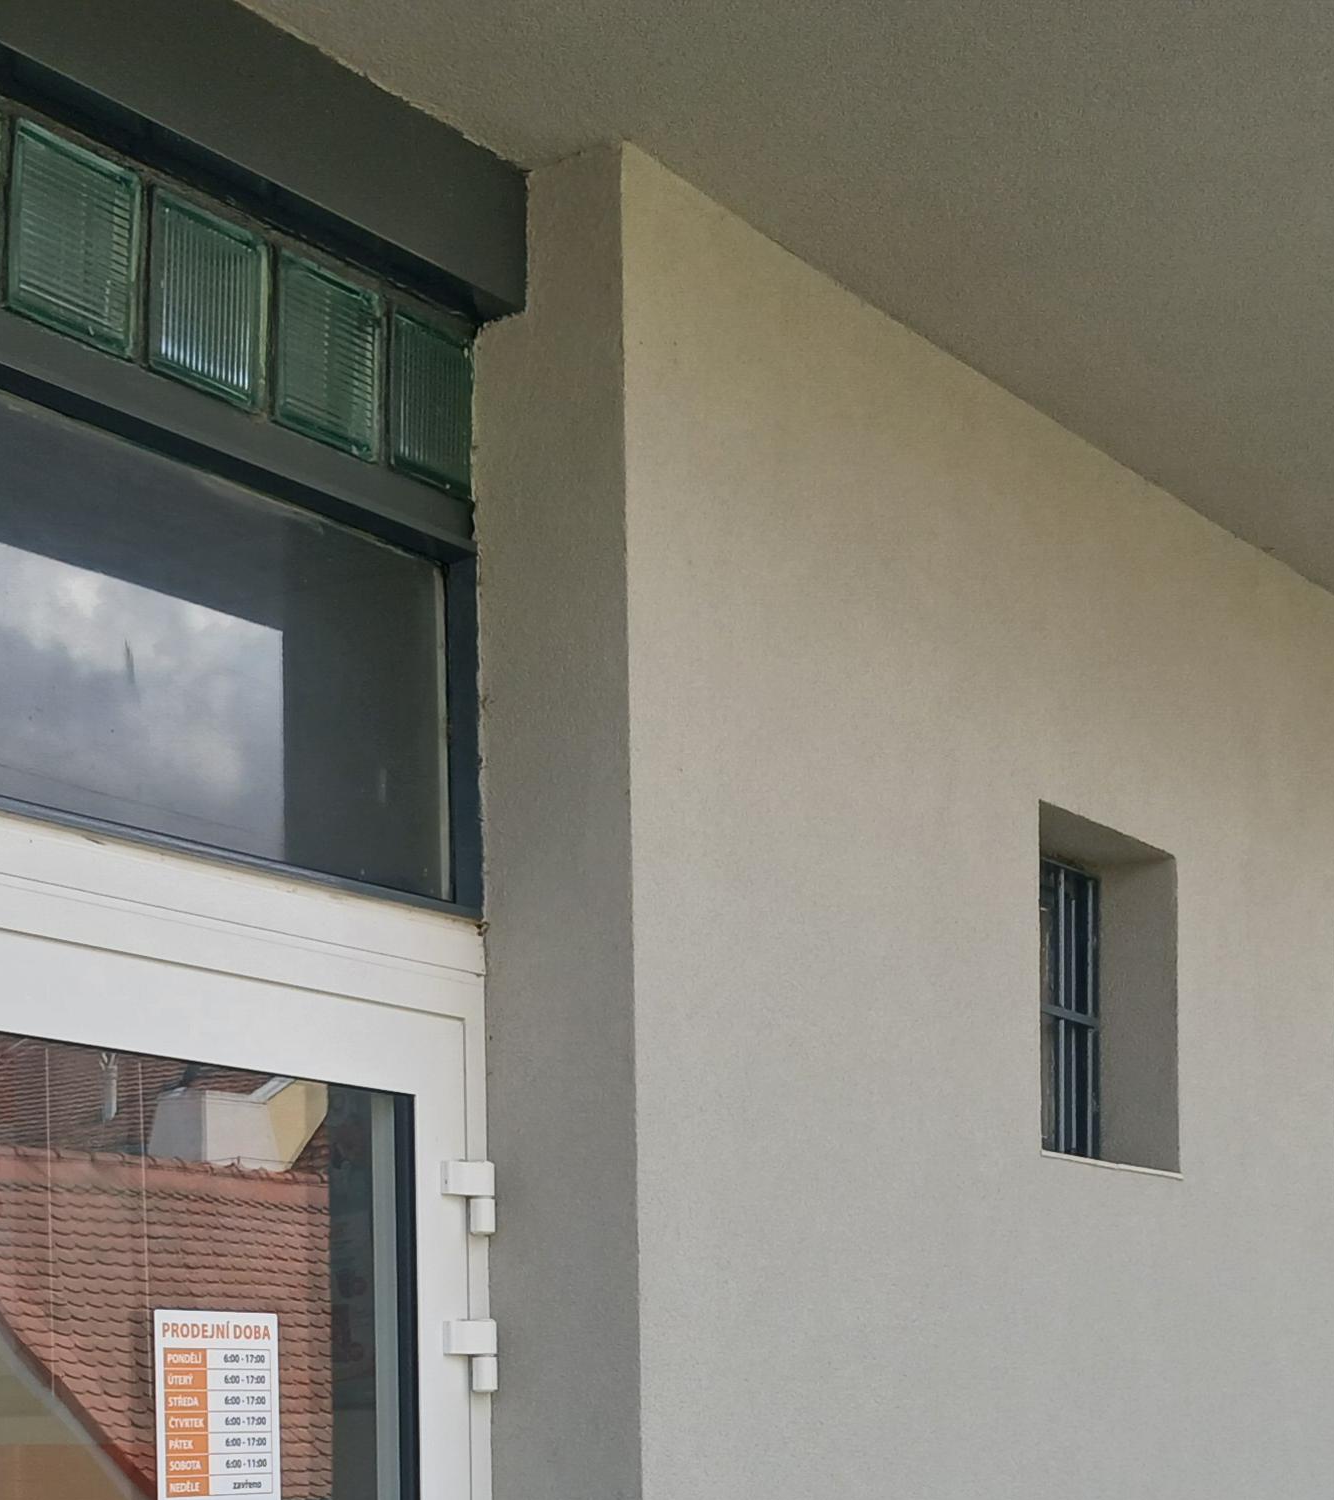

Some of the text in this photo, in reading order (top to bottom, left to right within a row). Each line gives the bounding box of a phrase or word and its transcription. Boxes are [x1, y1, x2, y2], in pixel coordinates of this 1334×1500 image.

[162, 1321, 271, 1340] PRODEJNÍ DOBA
[167, 1352, 202, 1365] PONDĚLÍ
[223, 1354, 240, 1364] 6:00
[246, 1354, 265, 1364] 17:00
[167, 1373, 193, 1385] ÚTERÝ
[224, 1375, 240, 1384] 6:00
[246, 1375, 266, 1384] 17:00
[168, 1395, 199, 1407] STŘEDA
[224, 1396, 241, 1405] 6:00
[247, 1396, 266, 1405] 17:00
[168, 1416, 204, 1428] ČTVRTEK
[225, 1417, 241, 1426] 6:00
[247, 1416, 267, 1426] 17:00
[169, 1438, 194, 1450] PÁTEK
[225, 1438, 241, 1447] 6:00
[247, 1437, 267, 1447] 17:00
[169, 1460, 201, 1471] SOBOTA
[225, 1459, 242, 1469] 6:00
[248, 1458, 267, 1468] 11:00
[169, 1480, 262, 1493] NEDĚLE zavřeno
